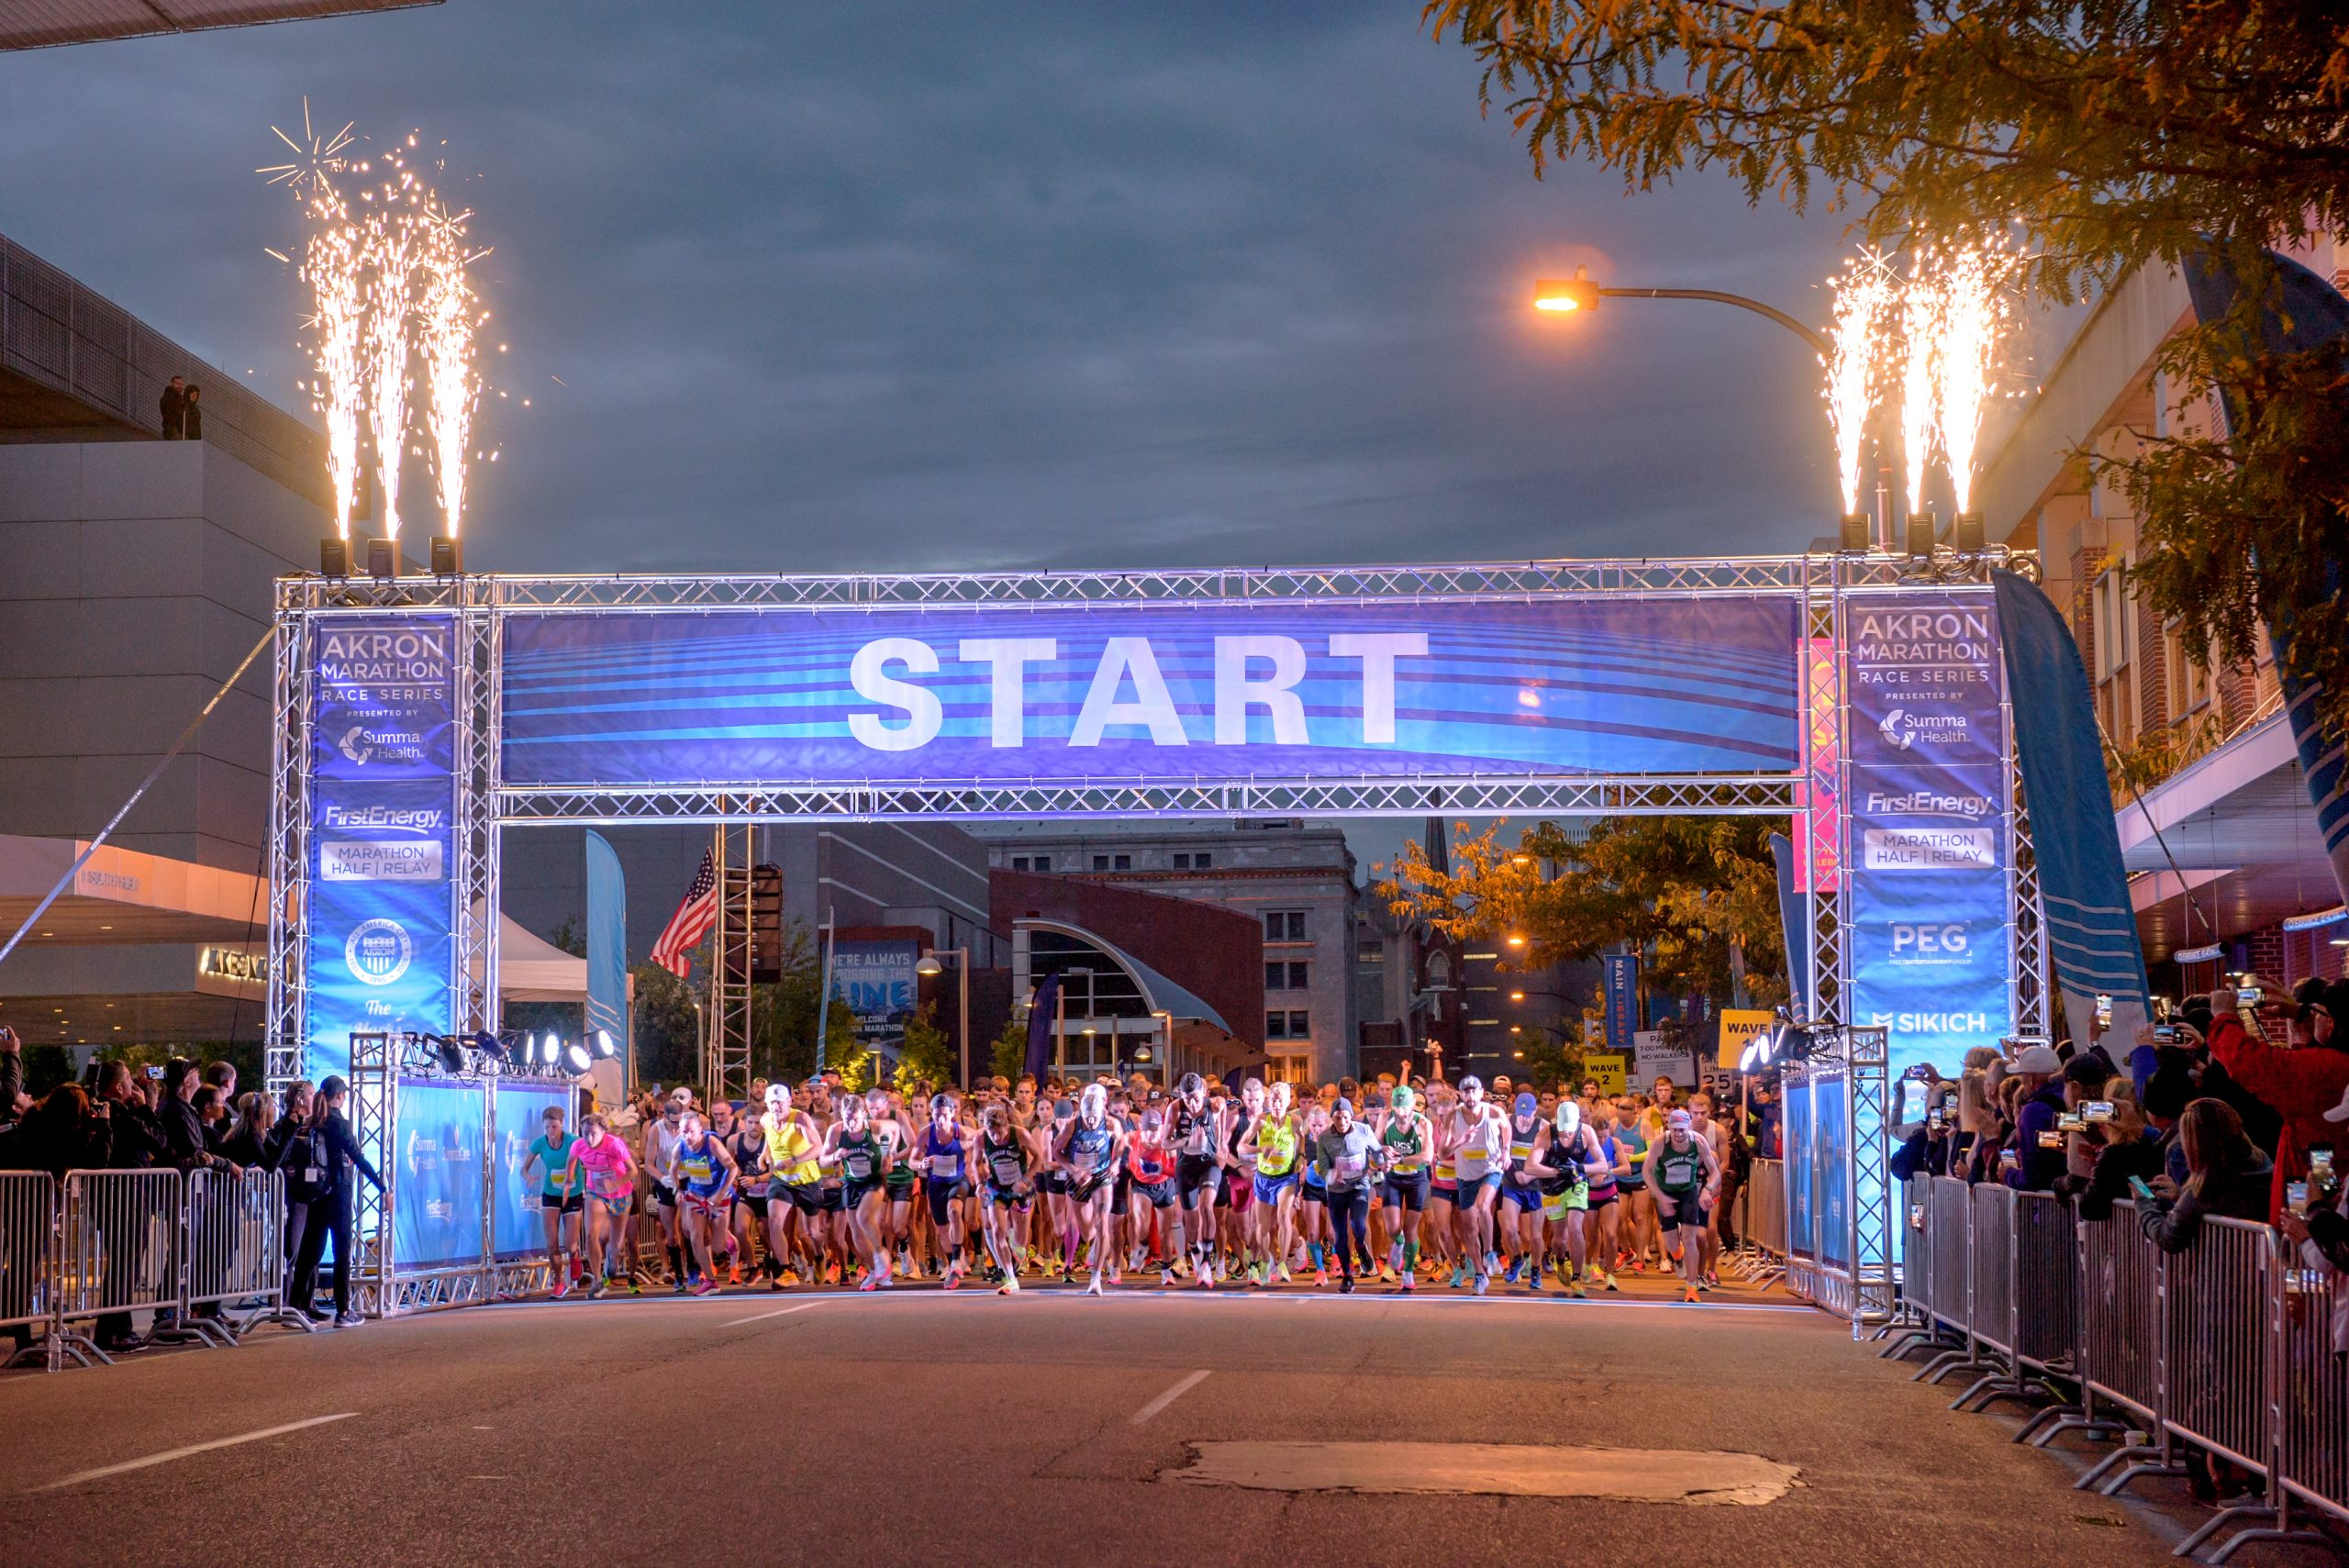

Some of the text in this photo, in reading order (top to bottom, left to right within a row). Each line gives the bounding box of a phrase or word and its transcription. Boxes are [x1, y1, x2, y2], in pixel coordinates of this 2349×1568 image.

[1859, 614, 1987, 639] AKRON
[322, 634, 444, 659] AKRON
[1858, 642, 1988, 661] MARATHON
[321, 662, 444, 680] MARATHON
[1859, 670, 1988, 684] RACE SERIES
[322, 688, 443, 702] RACE SERIES
[848, 632, 1428, 751] START
[1904, 714, 1967, 728] Summa
[363, 730, 421, 744] Summa
[1920, 730, 1967, 743] Health
[377, 746, 420, 759] Health
[1866, 792, 1992, 816] FirstEnergy
[325, 806, 441, 828] FirstEnergy
[1883, 834, 1975, 847] MARATHON
[339, 847, 424, 860] MARATHON
[1876, 851, 1919, 863] HALF
[1932, 850, 1983, 862] RELAY
[331, 862, 371, 874] HALF
[383, 862, 431, 874] RELAY
[1893, 925, 1967, 952] PEG
[362, 948, 395, 956] AKRON
[864, 953, 910, 966] ALWAYS
[365, 999, 392, 1016] The
[1615, 959, 1627, 1043] MAIN LIBRARY
[864, 1023, 904, 1032] MARATHON
[1727, 1023, 1767, 1034] WAVE
[1898, 1012, 1987, 1033] SIKICH
[1590, 1064, 1620, 1073] WAVE
[1602, 1074, 1610, 1084] 2
[1703, 1073, 1731, 1090] 25
